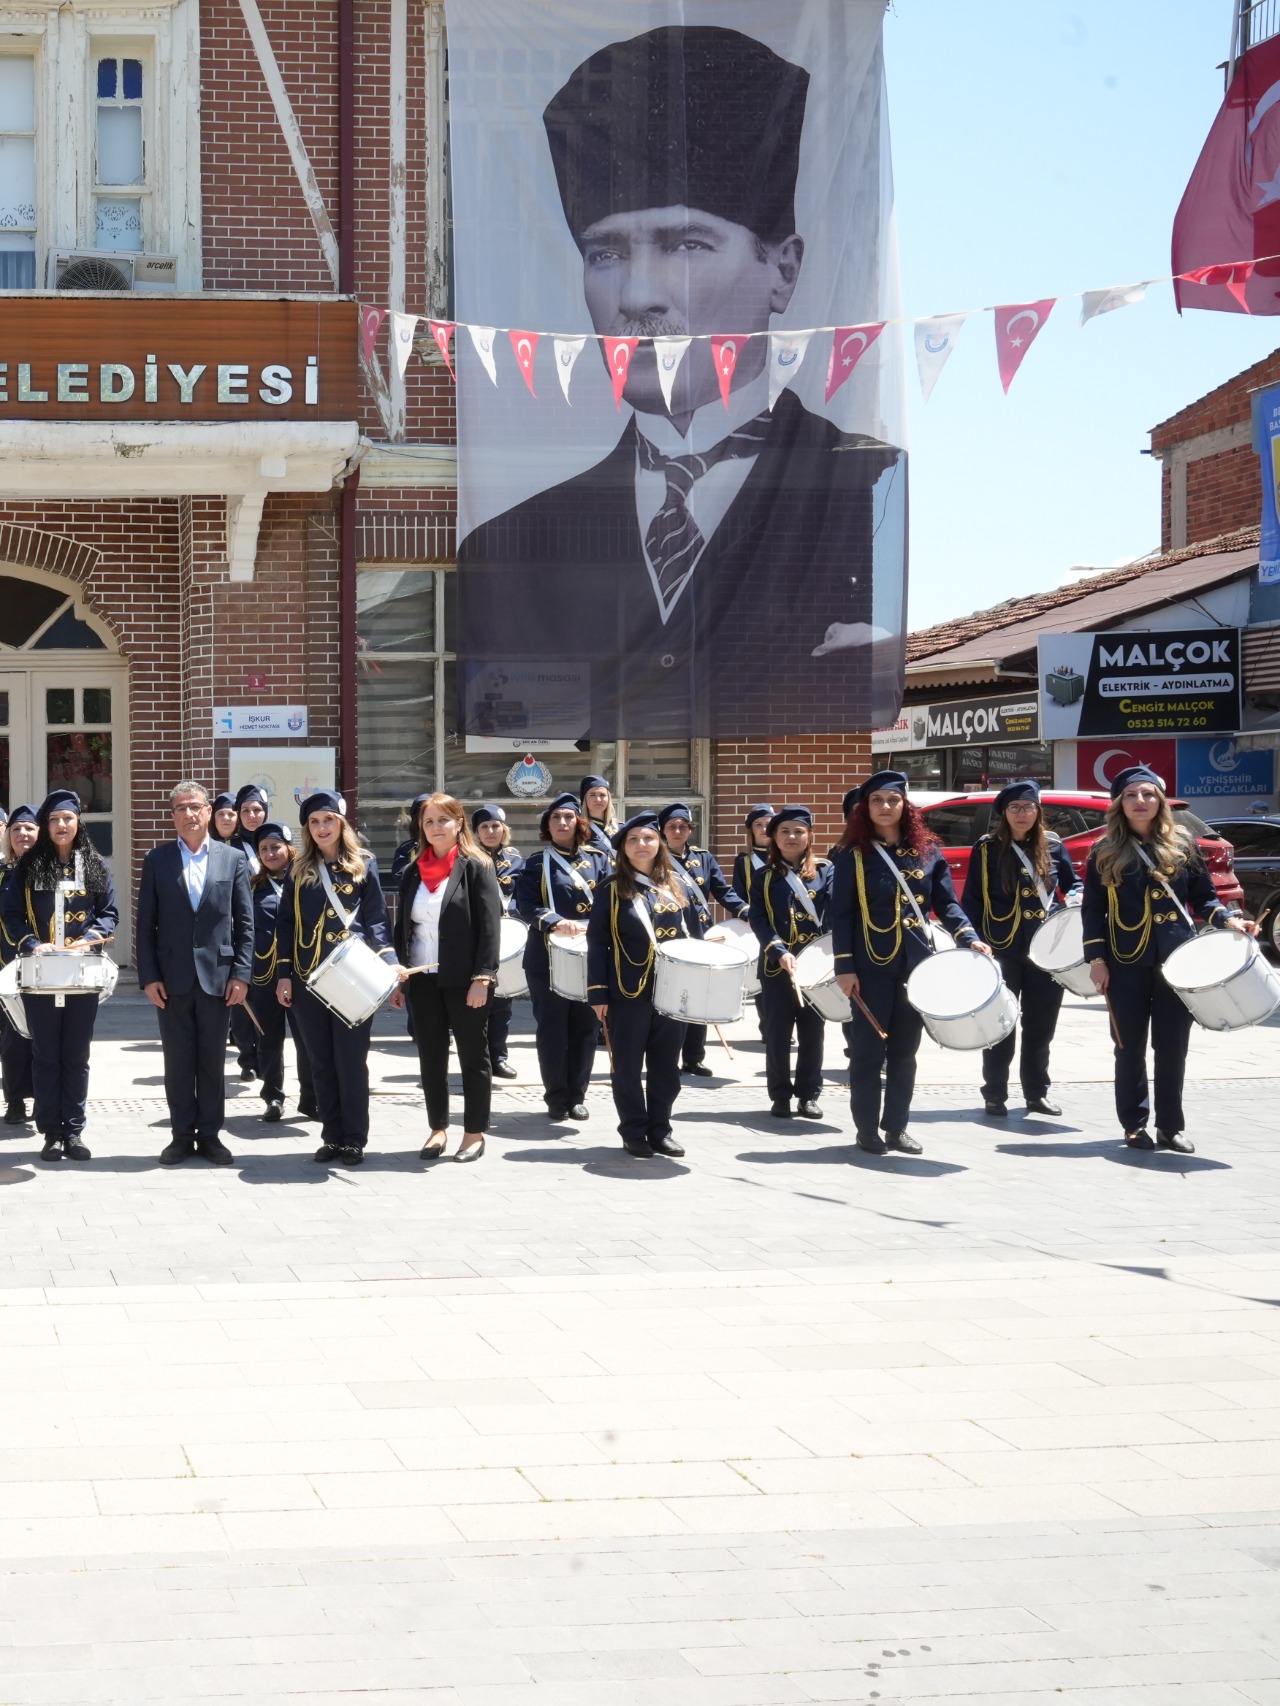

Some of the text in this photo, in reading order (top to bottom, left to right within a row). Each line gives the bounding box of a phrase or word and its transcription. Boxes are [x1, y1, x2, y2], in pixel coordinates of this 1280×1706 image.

[1099, 640, 1231, 672] MALÇOK
[1102, 680, 1150, 692] ELEKTRİK
[1161, 679, 1230, 690] AYDINLATMA
[1167, 700, 1215, 712] MALÇOK
[248, 715, 271, 723] İŞKUR
[927, 706, 1000, 741] MALÇOK
[1127, 716, 1207, 729] 0532 514 72 60
[1199, 773, 1252, 785] YENİŞEHİR
[1184, 784, 1267, 795] ÜLKÜ OCAKLARI
